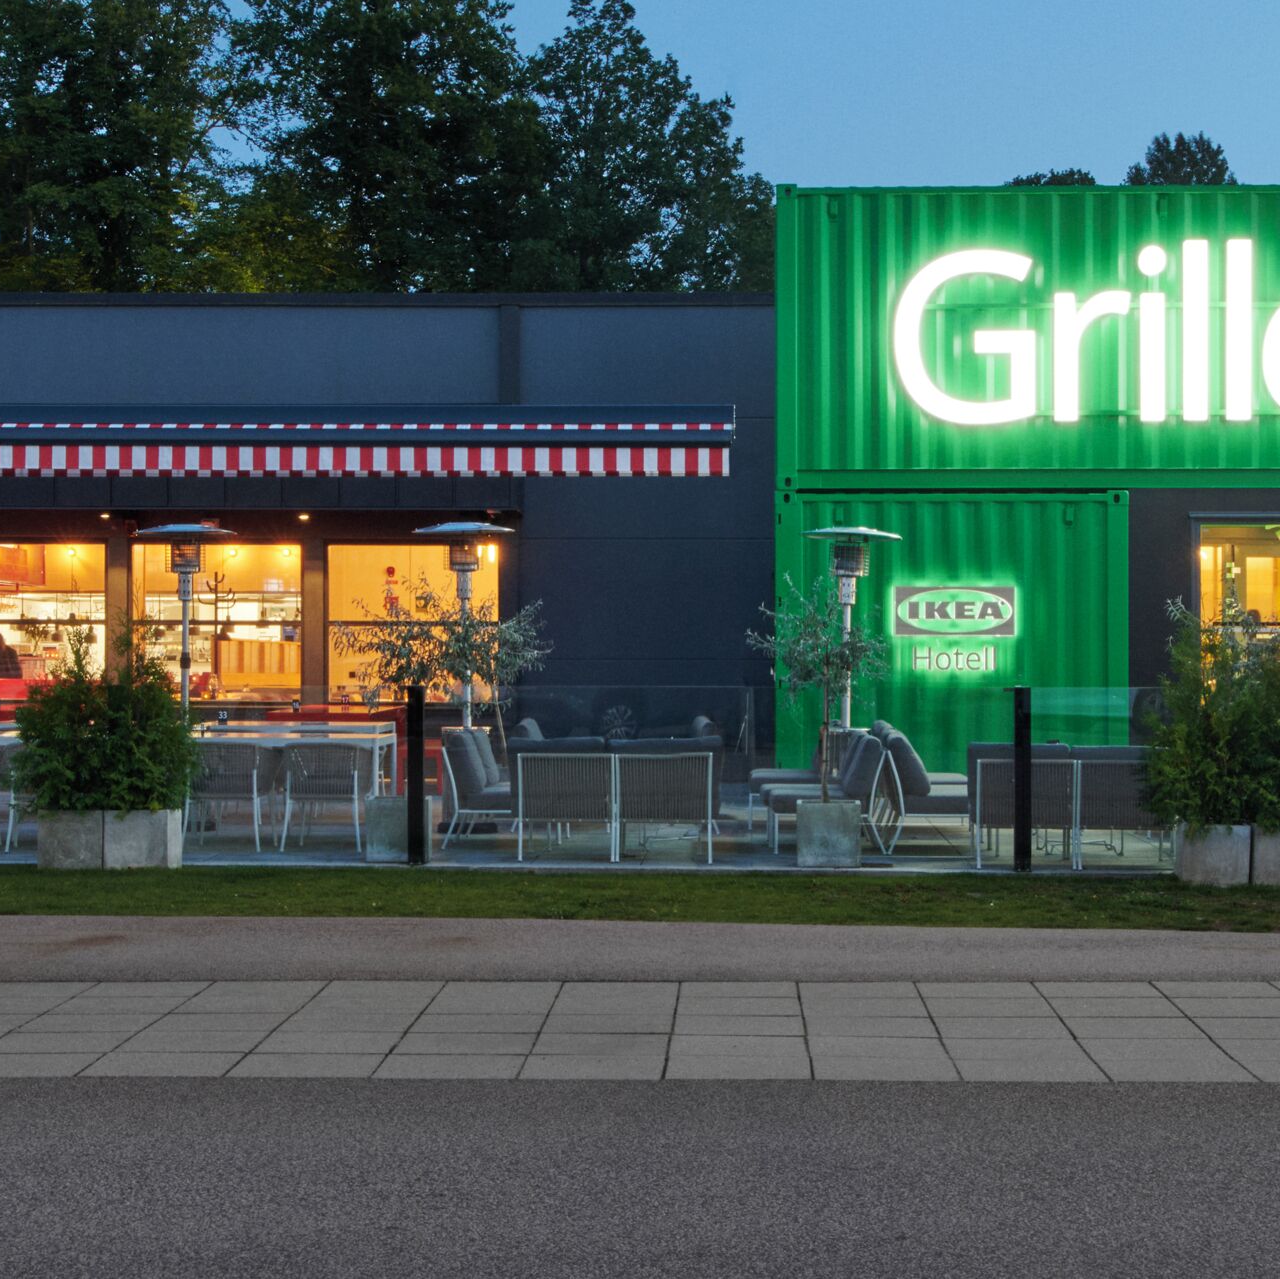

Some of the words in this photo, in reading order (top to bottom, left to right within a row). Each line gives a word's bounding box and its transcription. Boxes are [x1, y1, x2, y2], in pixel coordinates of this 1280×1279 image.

[908, 601, 1004, 619] IKEA
[913, 646, 996, 670] Hotell
[218, 711, 227, 719] 33
